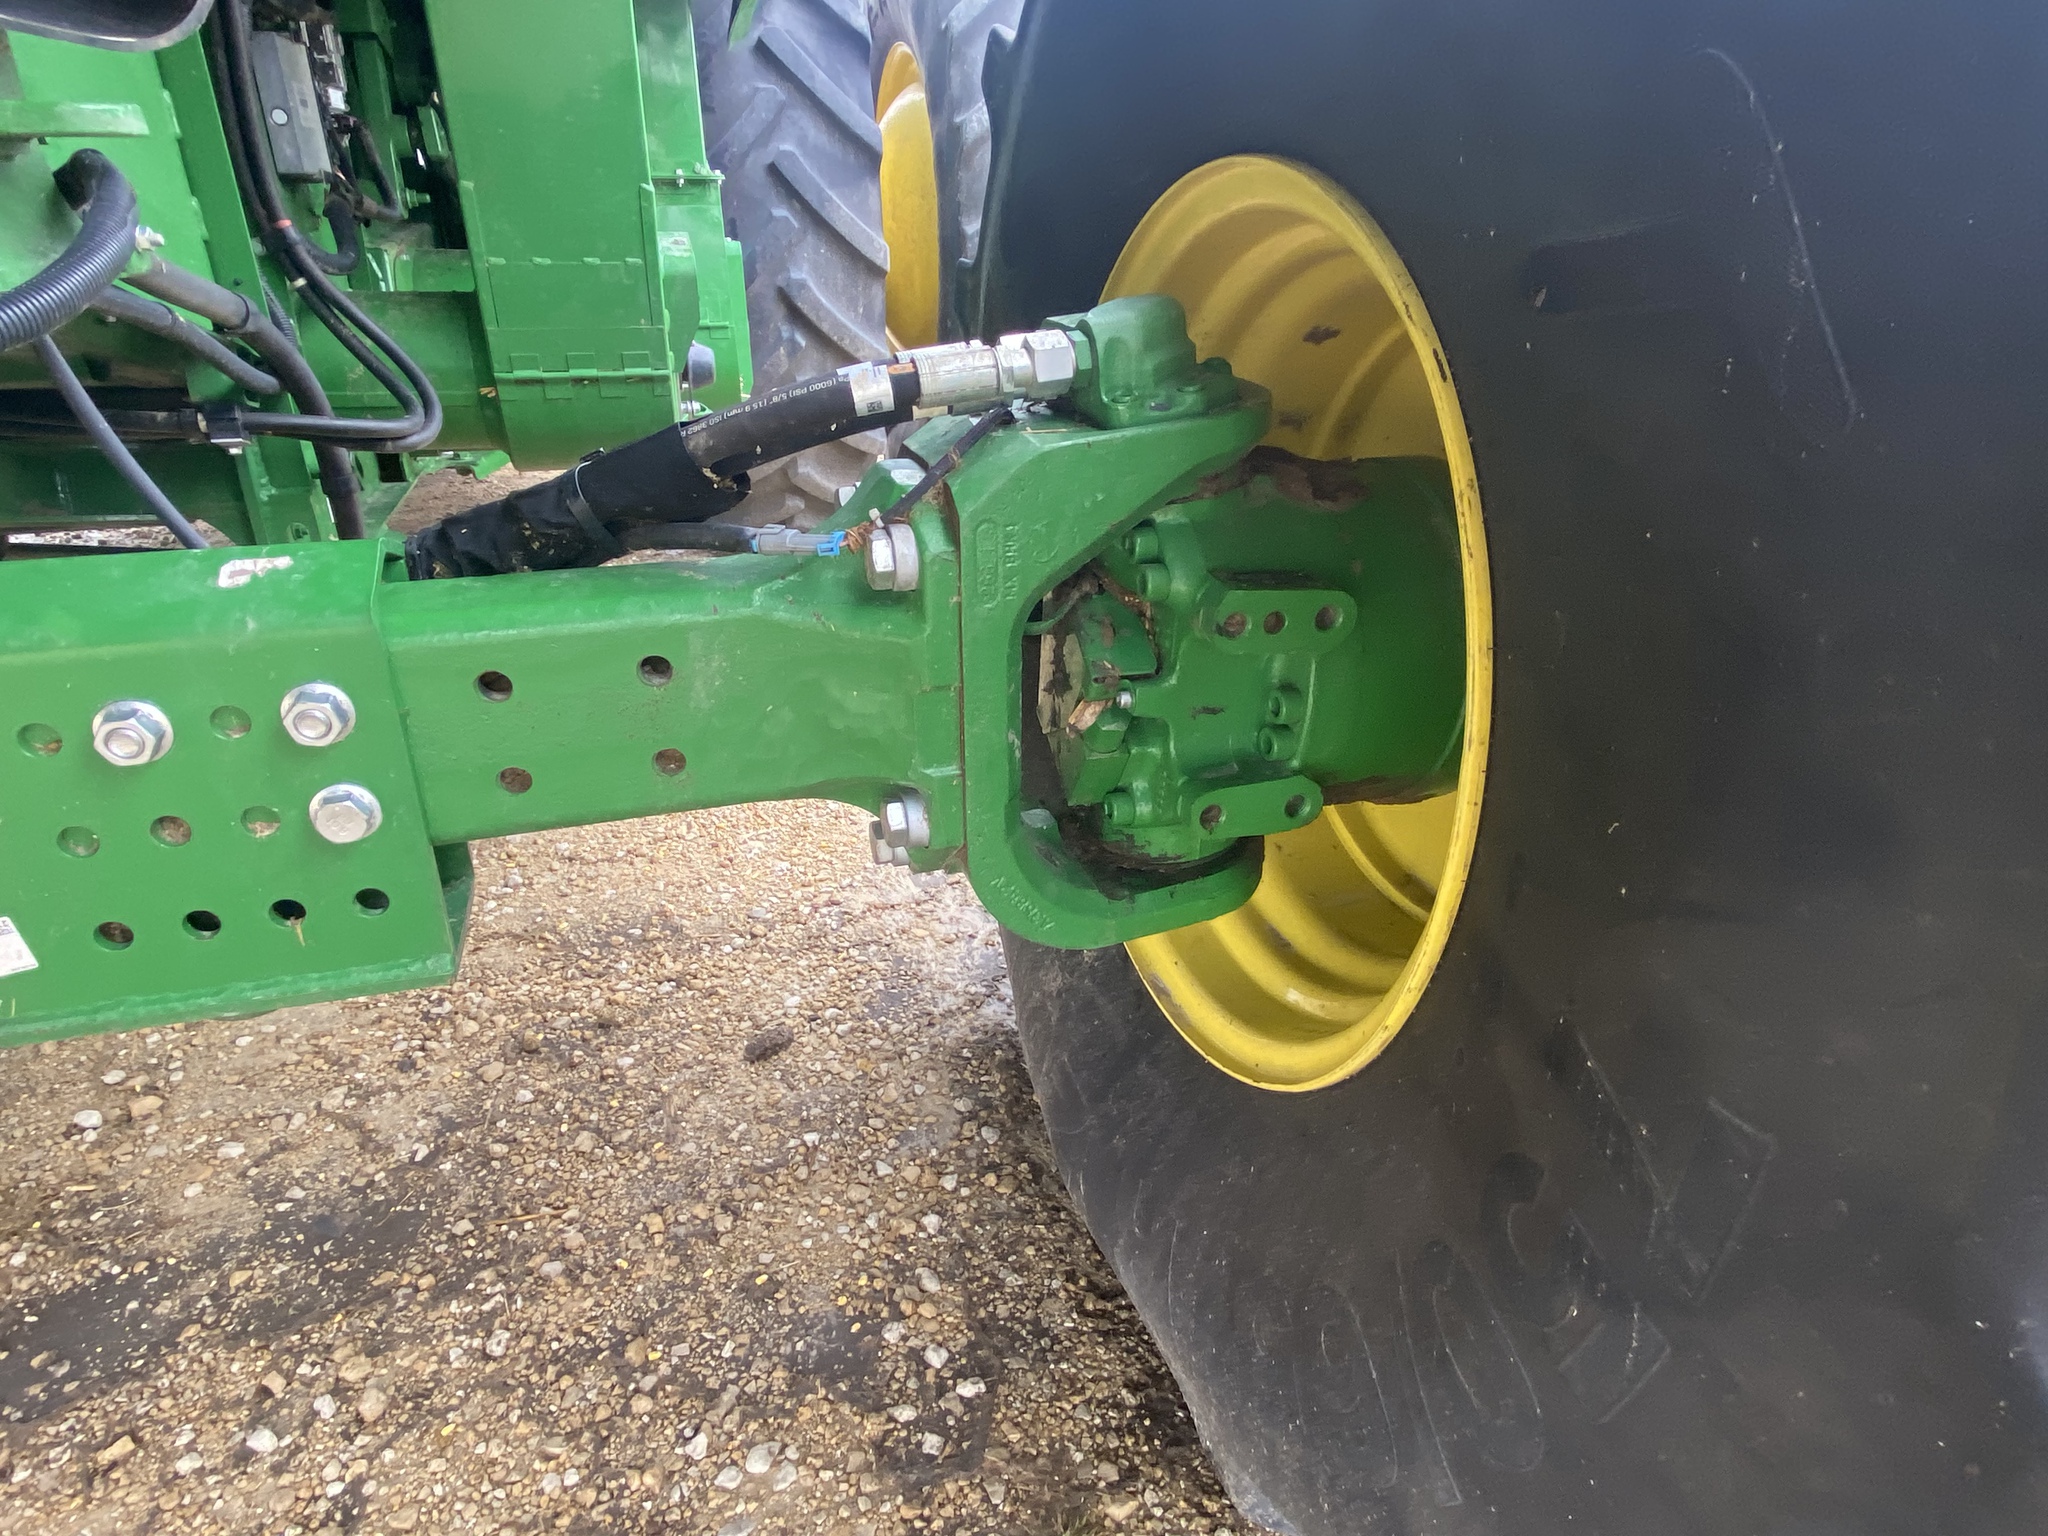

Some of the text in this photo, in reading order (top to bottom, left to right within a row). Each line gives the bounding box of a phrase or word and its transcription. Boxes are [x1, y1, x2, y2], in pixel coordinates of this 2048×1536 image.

[809, 377, 836, 392] (6000
[789, 386, 808, 397] PSI)
[709, 414, 723, 425] ISO
